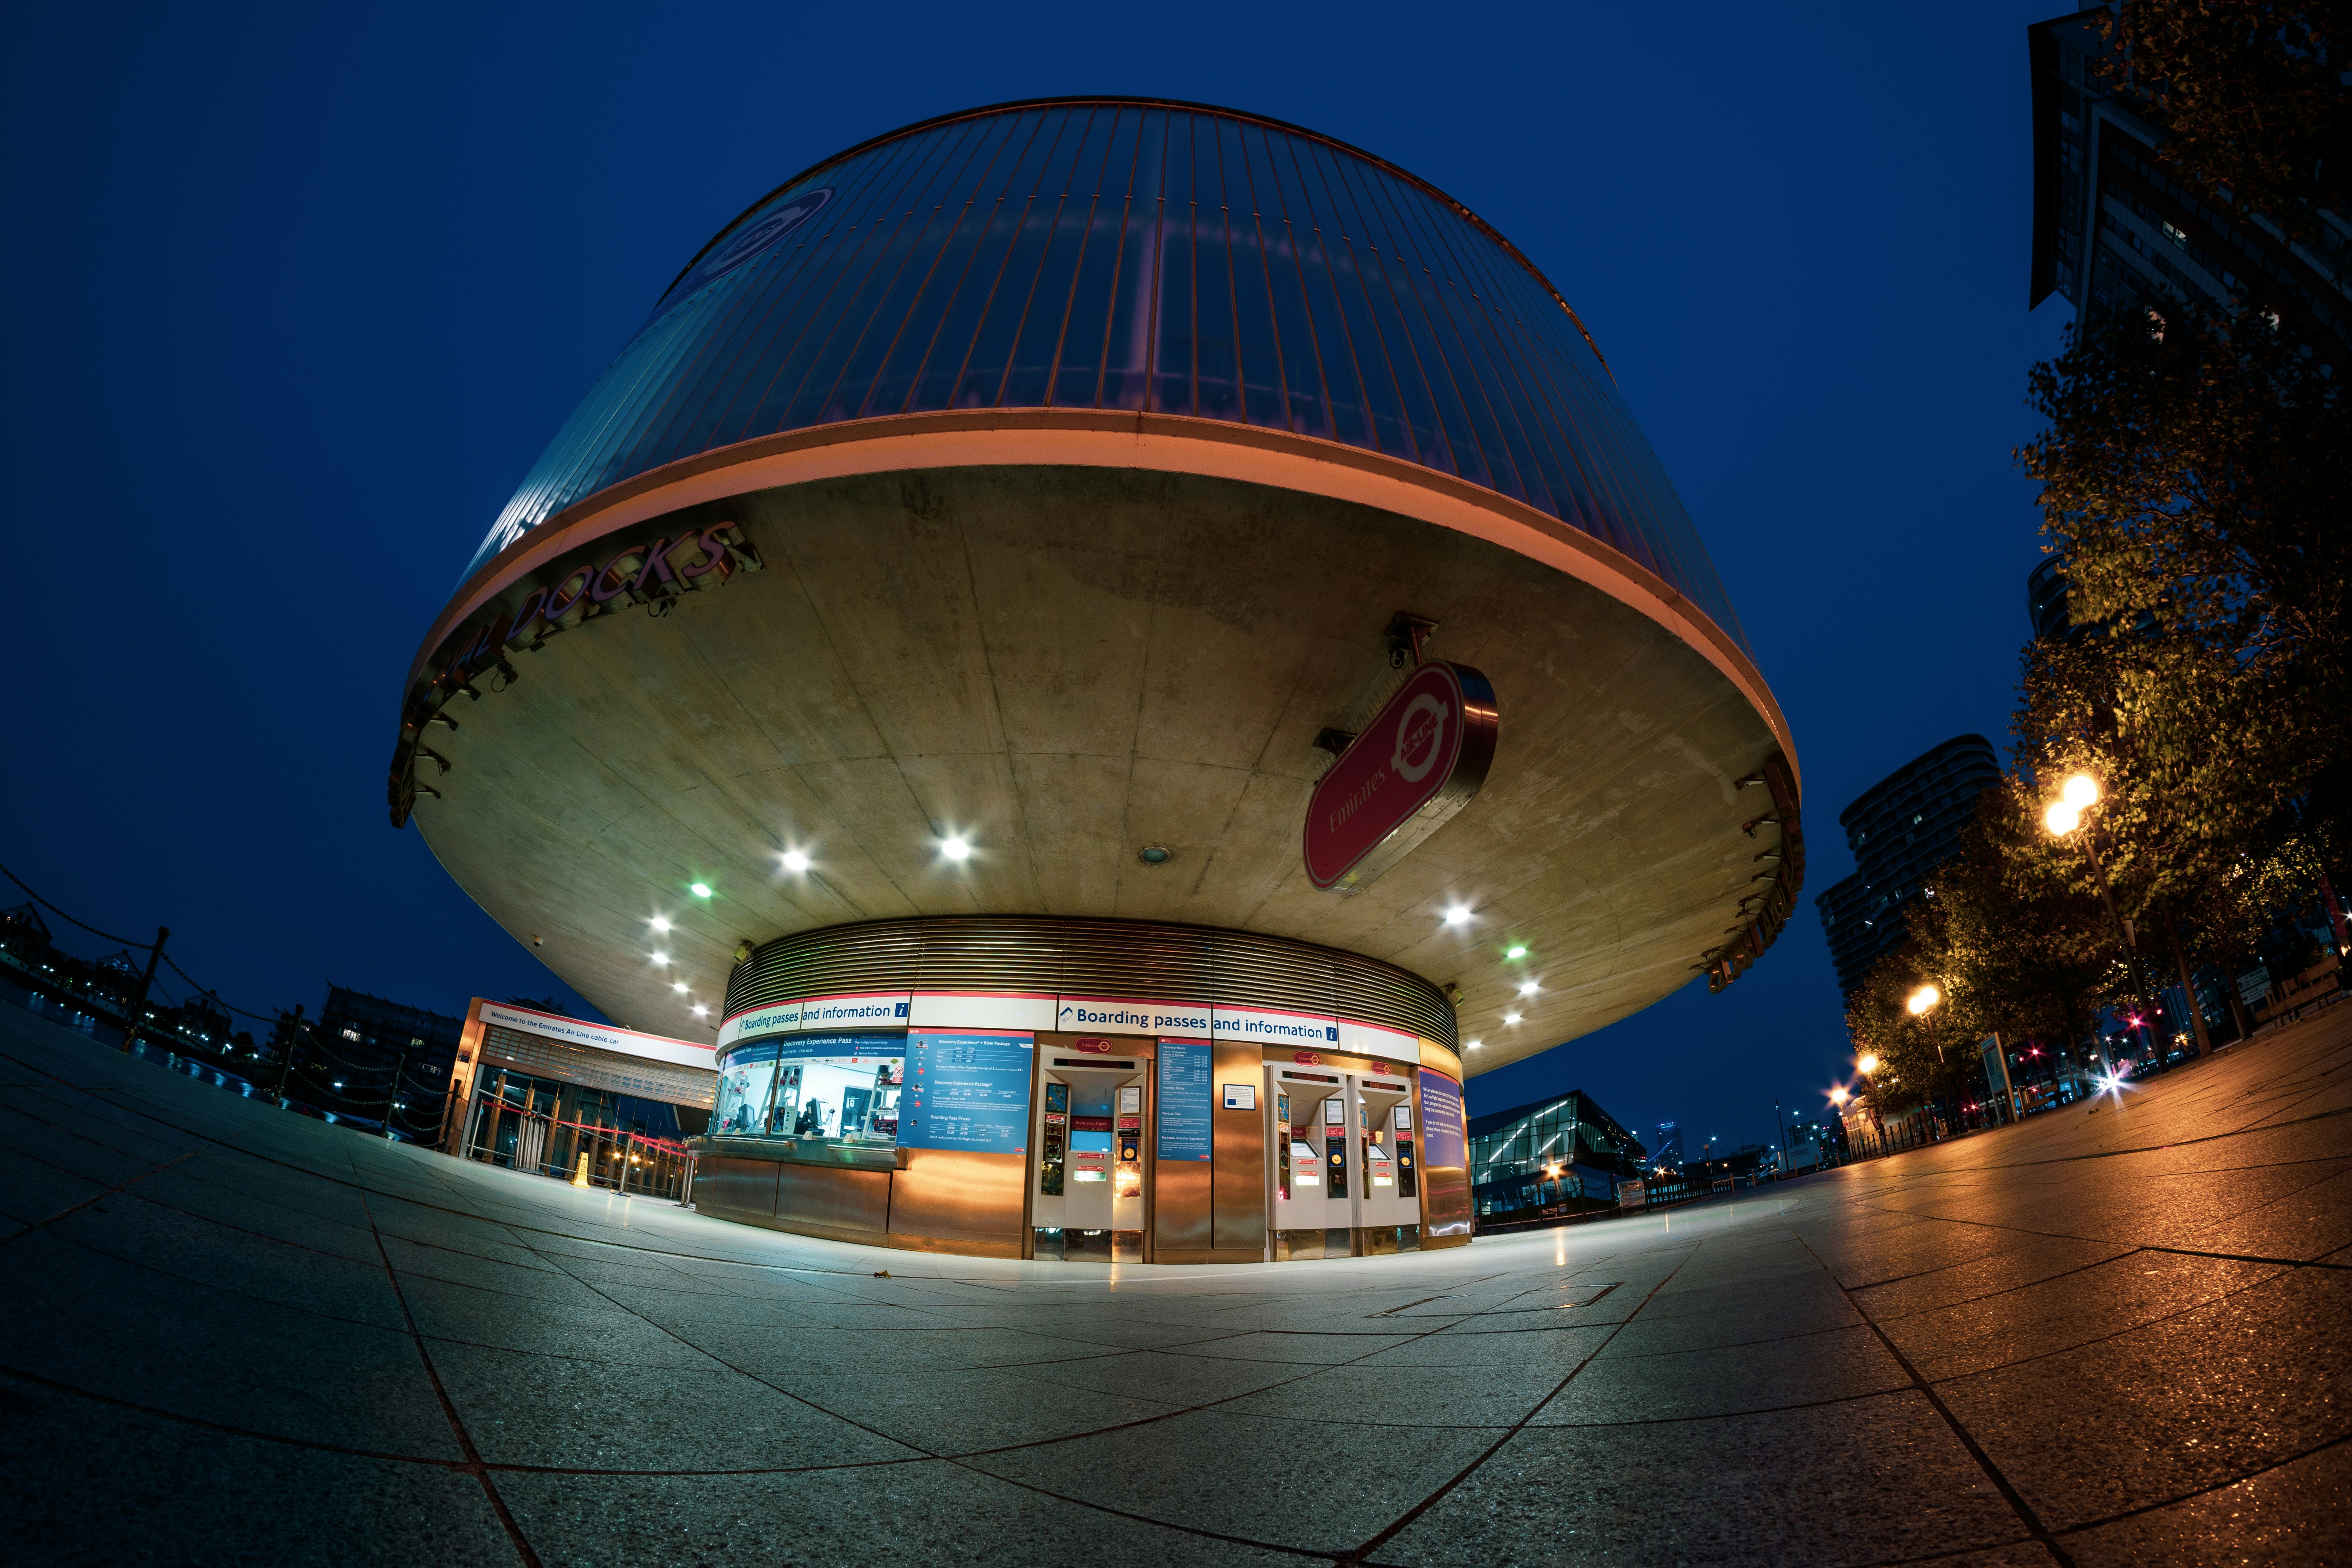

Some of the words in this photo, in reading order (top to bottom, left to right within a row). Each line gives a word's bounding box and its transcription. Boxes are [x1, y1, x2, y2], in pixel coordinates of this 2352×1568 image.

[505, 521, 738, 642] DOCKS
[1330, 767, 1385, 833] Emirates
[491, 1011, 517, 1022] Welcome
[539, 1022, 564, 1033] Emirates
[745, 1016, 771, 1029] Boarding
[772, 1013, 798, 1027] passes
[803, 1008, 820, 1020] and
[822, 1005, 890, 1019] information
[1077, 1009, 1149, 1028] Boarding
[1154, 1015, 1207, 1029] passes
[1214, 1019, 1240, 1031] and
[1246, 1019, 1322, 1038] information
[807, 1038, 836, 1046] Experience
